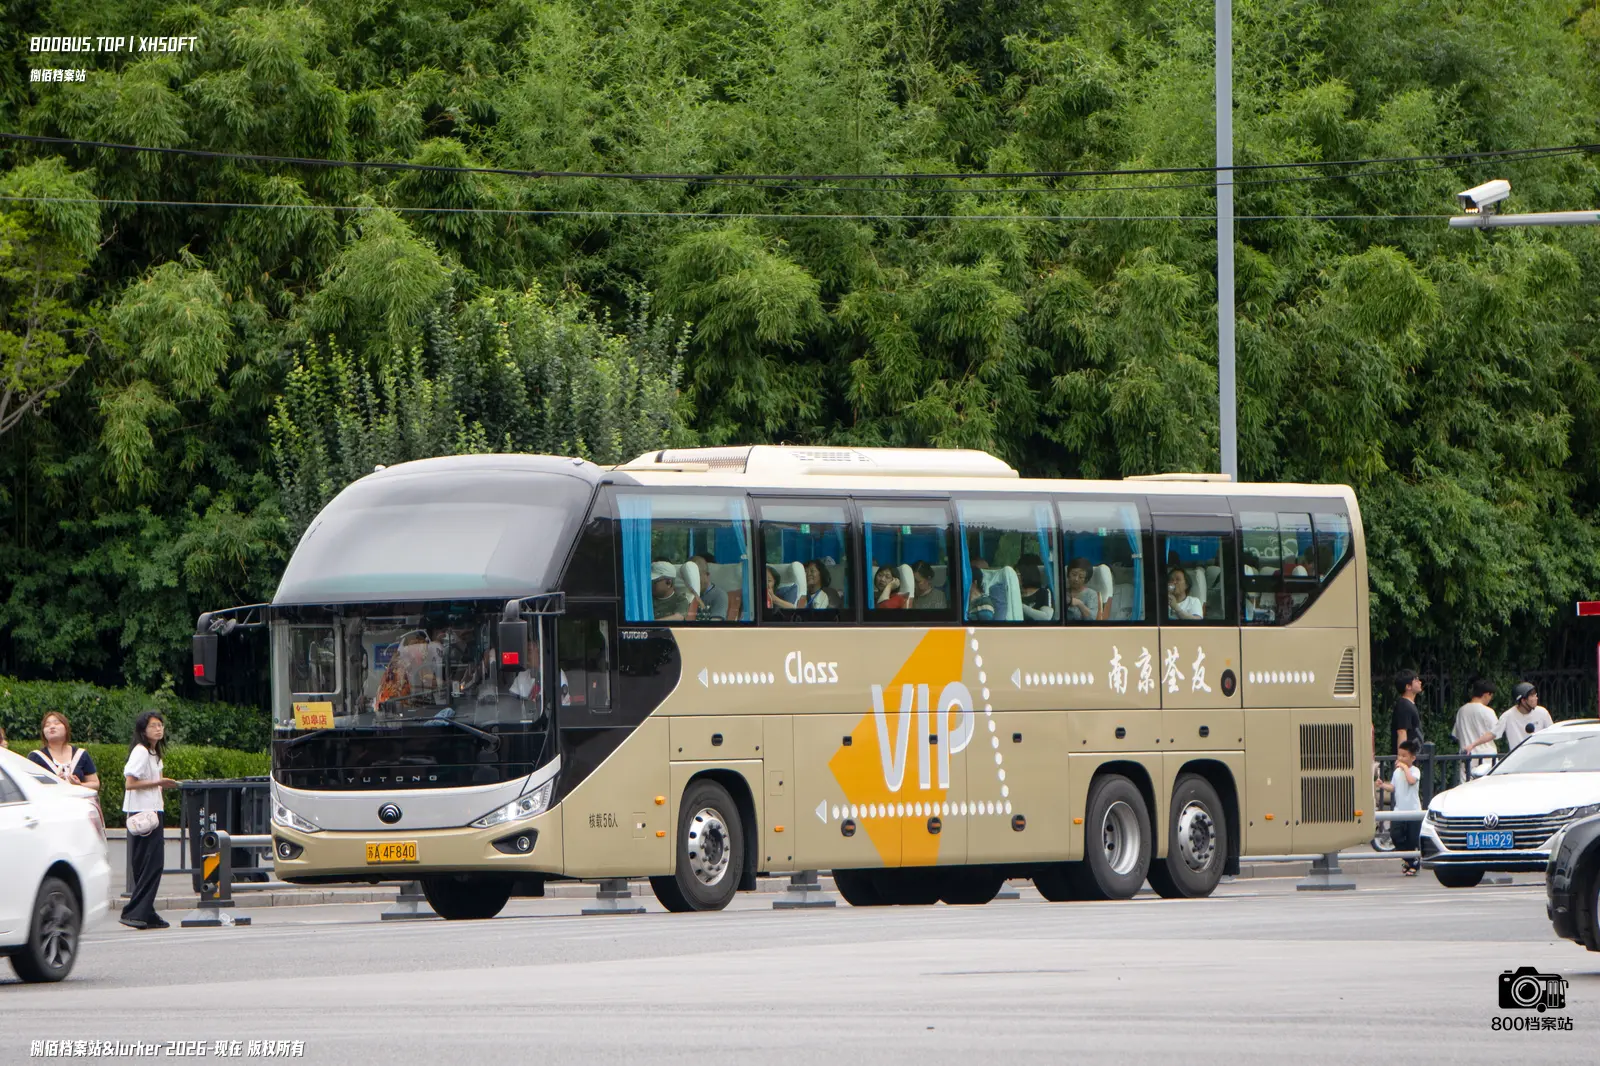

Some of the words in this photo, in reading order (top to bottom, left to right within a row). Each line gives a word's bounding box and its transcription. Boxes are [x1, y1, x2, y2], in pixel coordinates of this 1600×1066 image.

[784, 650, 839, 684] Class
[1108, 645, 1212, 694] 南京荃友
[871, 681, 975, 792] VIP
[347, 775, 437, 783] YUTONG
[589, 812, 618, 828] 核载56人
